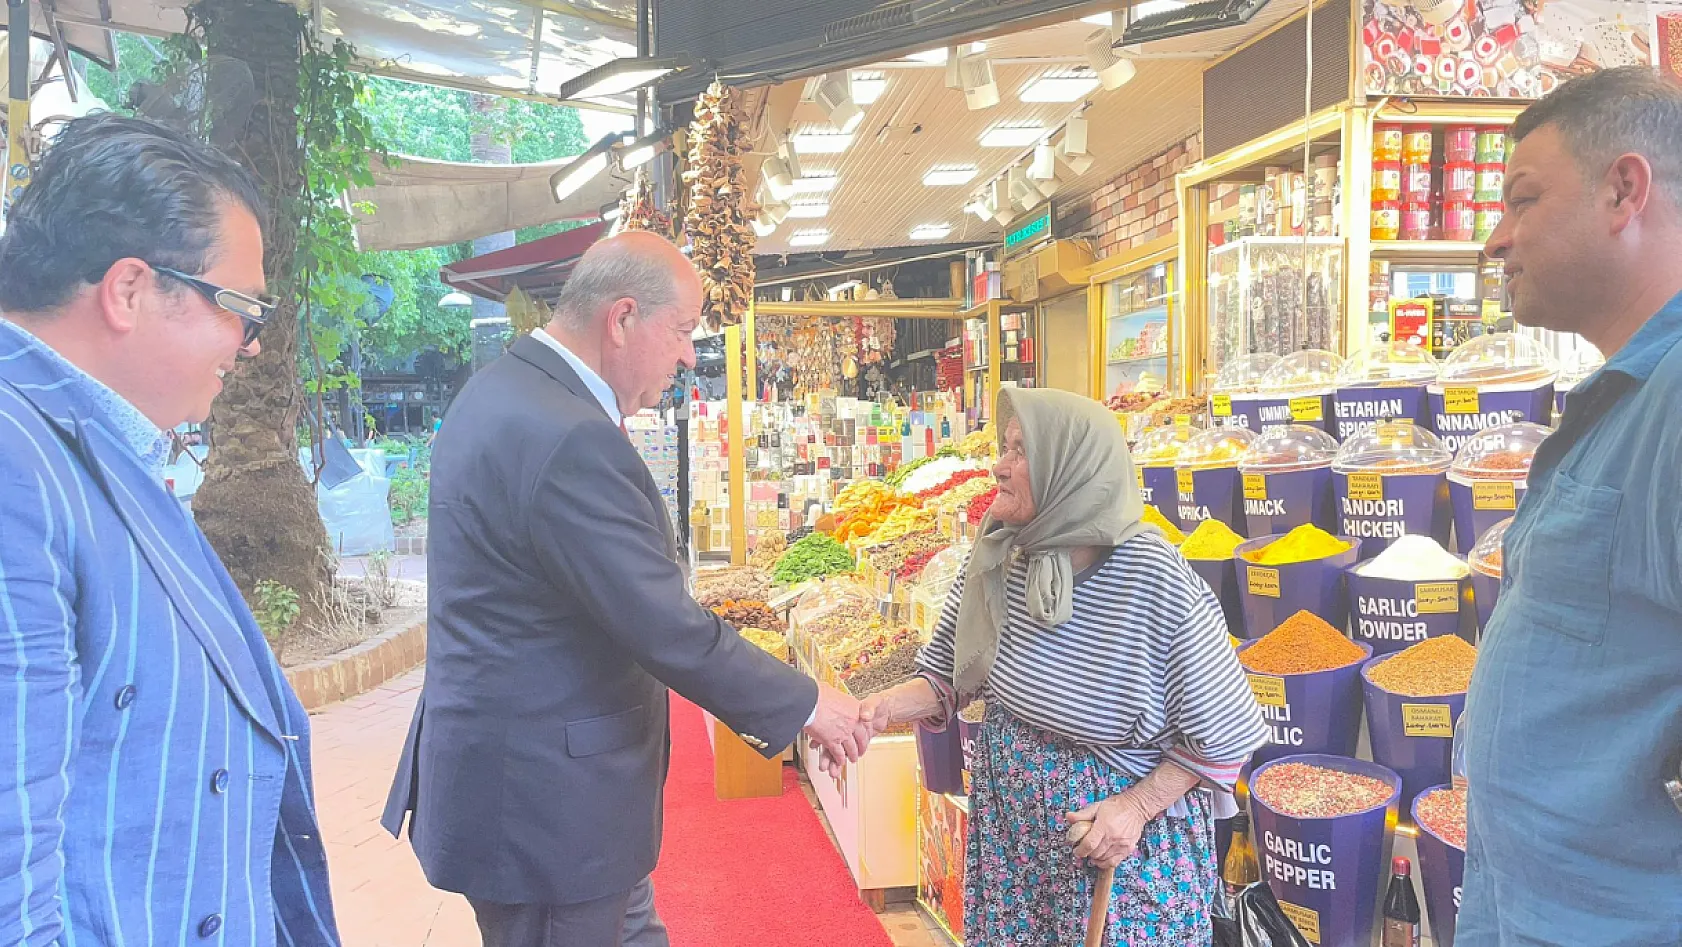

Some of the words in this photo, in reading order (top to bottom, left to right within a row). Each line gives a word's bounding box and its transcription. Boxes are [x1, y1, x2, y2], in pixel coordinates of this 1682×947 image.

[1343, 518, 1406, 538] CHICKEN
[1264, 830, 1332, 865] GARLIC
[1265, 854, 1336, 890] PEPPER
